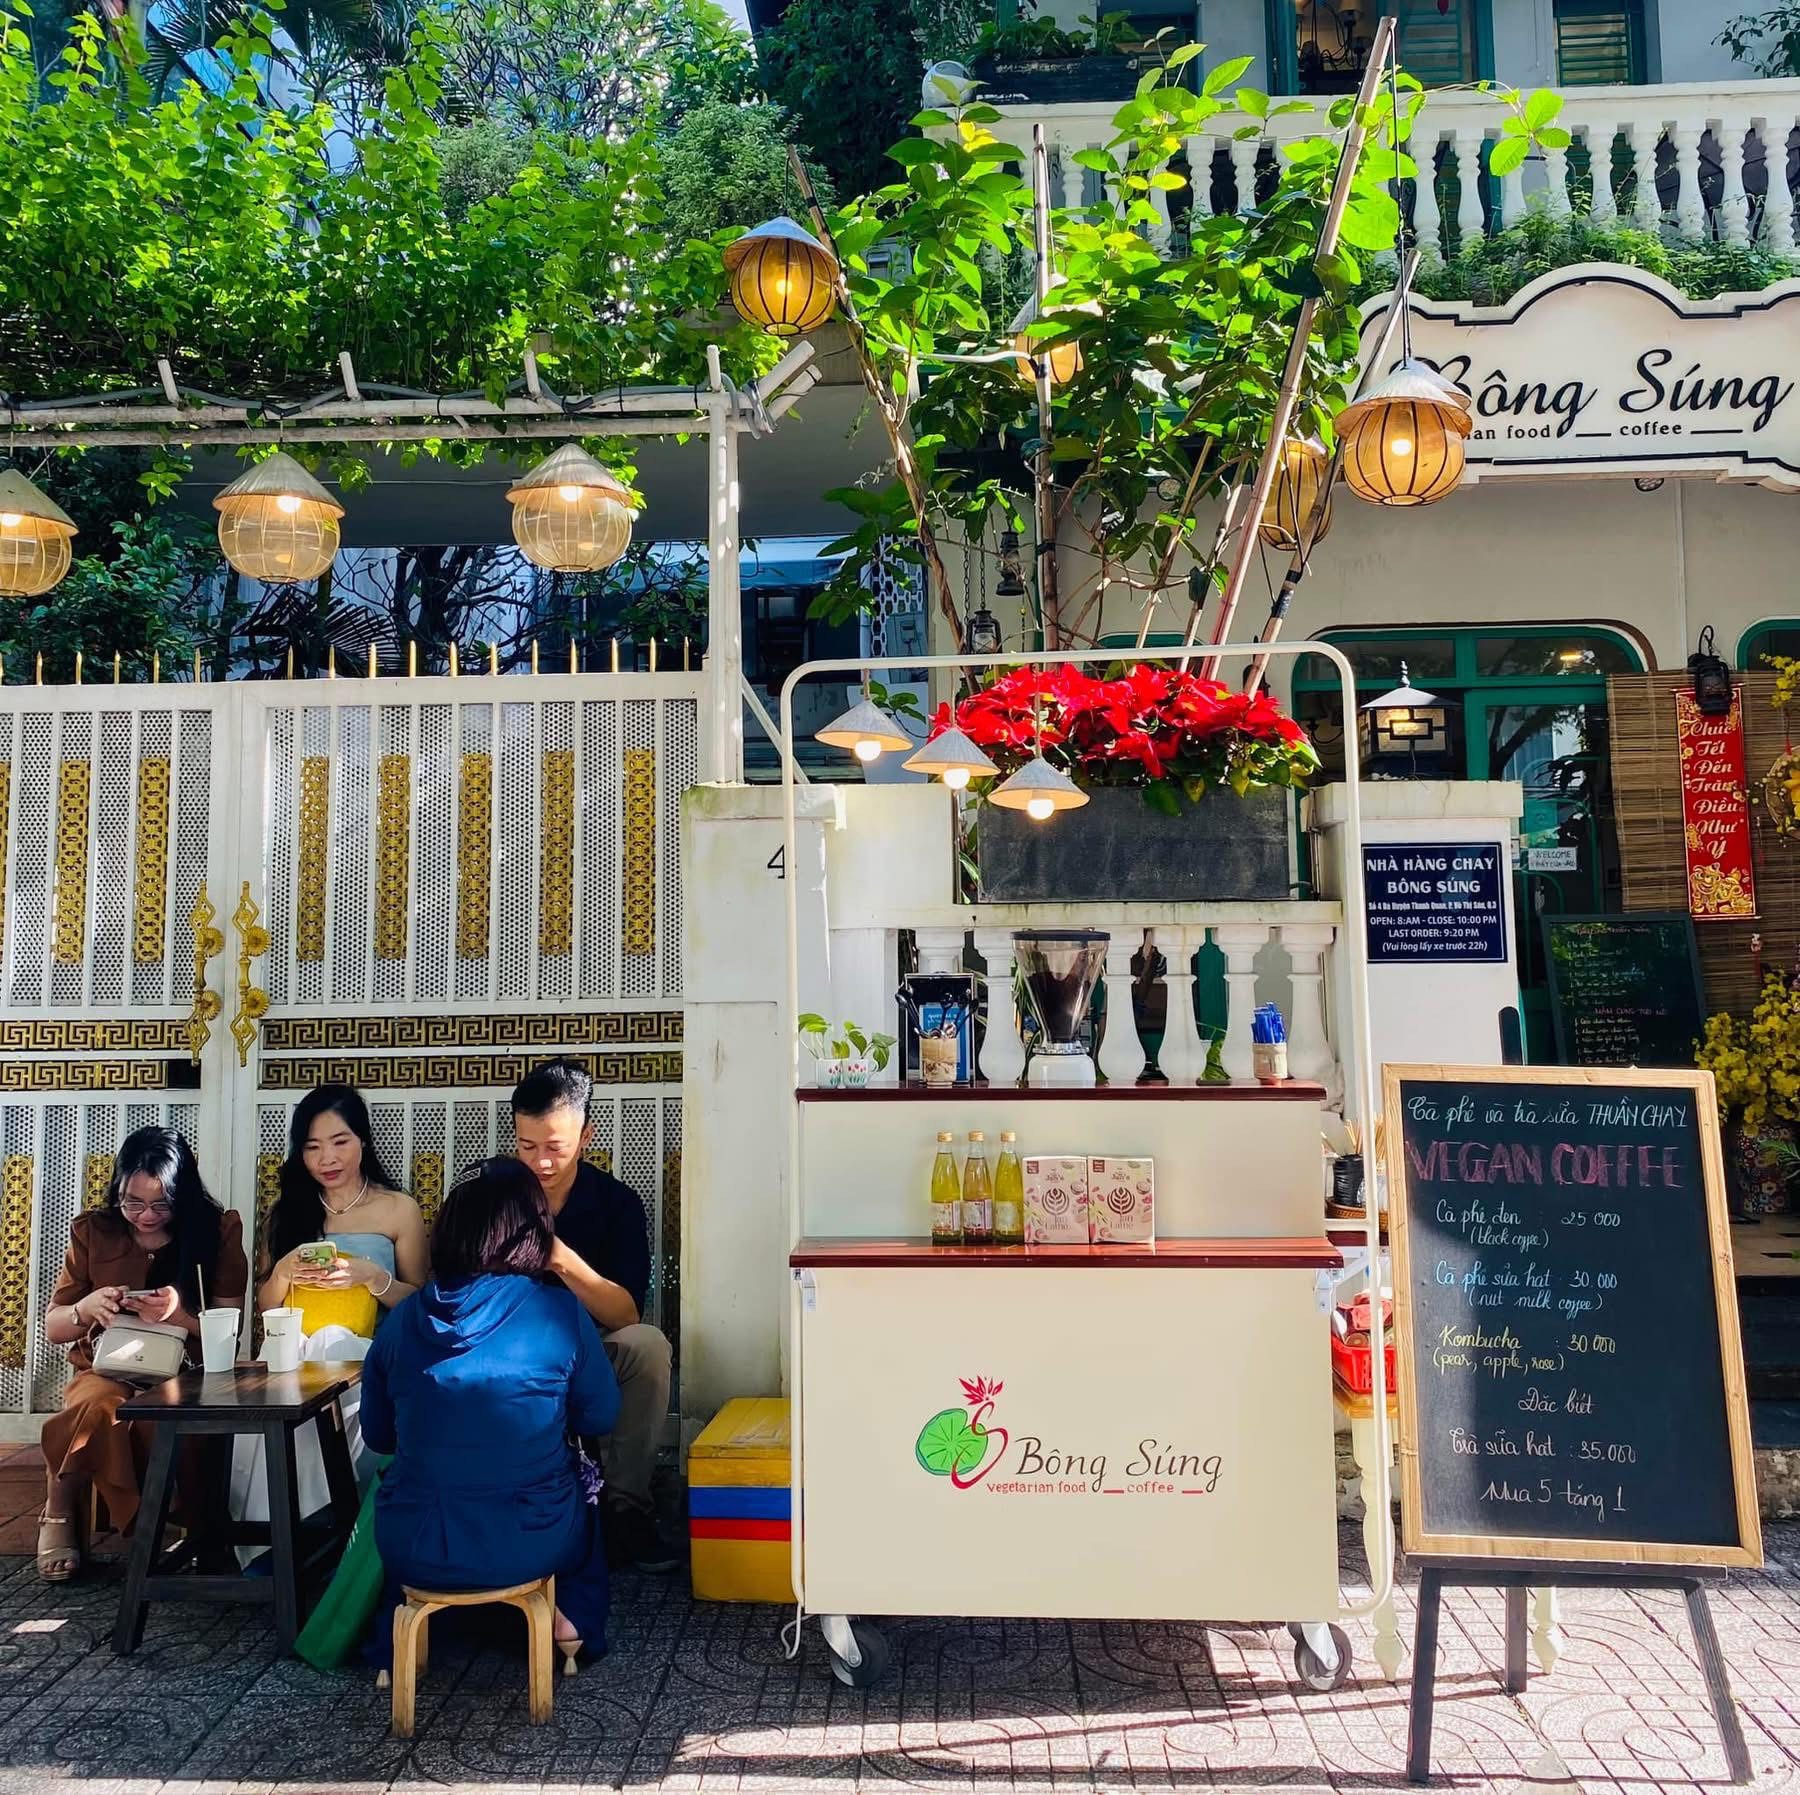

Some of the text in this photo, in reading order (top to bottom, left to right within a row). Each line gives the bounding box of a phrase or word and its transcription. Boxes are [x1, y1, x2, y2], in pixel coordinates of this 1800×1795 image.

[1619, 348, 1795, 433] Súng
[1507, 424, 1550, 439] food
[1620, 420, 1683, 437] coffee
[1690, 721, 1732, 737] Chúc
[1695, 740, 1726, 756] Tết
[1693, 758, 1733, 775] Đến
[1693, 797, 1738, 815] Điều
[1696, 819, 1738, 835] Như
[1707, 836, 1727, 860] Ý
[767, 844, 785, 879] 4
[1366, 854, 1494, 871] NHÀ HÀNG CHAY
[1387, 876, 1481, 894] BÔNG SÚNG
[1370, 917, 1396, 925] OPEN:
[1397, 916, 1421, 925] 8:AM
[1427, 916, 1456, 925] CLOSE:
[1457, 916, 1481, 924] 10:00
[1482, 915, 1497, 924] PM
[1388, 928, 1480, 938] LAST ORDER: 9:20 PM
[1382, 942, 1399, 953] (Vui
[1468, 941, 1488, 951] 22h)
[1445, 1095, 1477, 1133] phê
[1485, 1103, 1505, 1124] và
[1513, 1099, 1540, 1125] trà
[1587, 1095, 1639, 1127] THUẦN
[1641, 1104, 1688, 1128] CHAY
[1404, 1139, 1685, 1188] VEGAN COFFEE
[1436, 1199, 1456, 1224] Cà
[1462, 1199, 1487, 1232] phê
[1491, 1201, 1522, 1225] đen
[1470, 1225, 1510, 1248] (black
[1513, 1287, 1552, 1310] milk
[1439, 1324, 1523, 1349] Kombucha
[1432, 1346, 1565, 1379] (pear, apple, rose)
[1449, 1427, 1480, 1455] Trà
[1485, 1428, 1521, 1456] sữa
[1015, 1436, 1224, 1494] Bông Súng
[986, 1480, 1175, 1495] vegetarian food coffee
[1480, 1480, 1532, 1503] Mua
[1537, 1478, 1552, 1504] 5
[1613, 1485, 1626, 1512] 1
